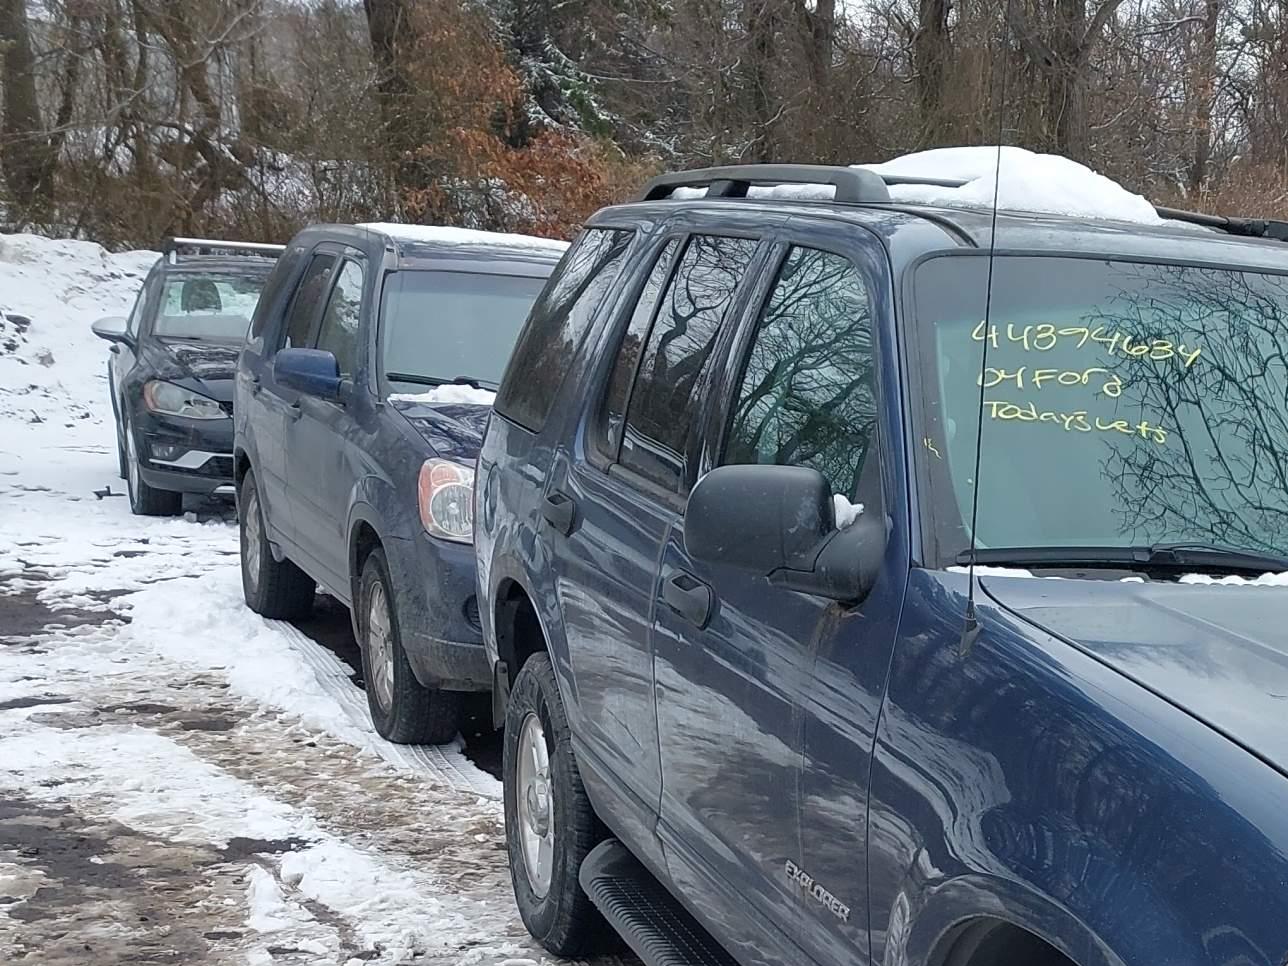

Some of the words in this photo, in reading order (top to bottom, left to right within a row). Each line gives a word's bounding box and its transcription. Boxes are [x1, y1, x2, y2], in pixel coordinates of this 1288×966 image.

[972, 320, 1201, 367] 44394634
[1032, 368, 1123, 397] Ford
[785, 859, 850, 923] EXPLORER
